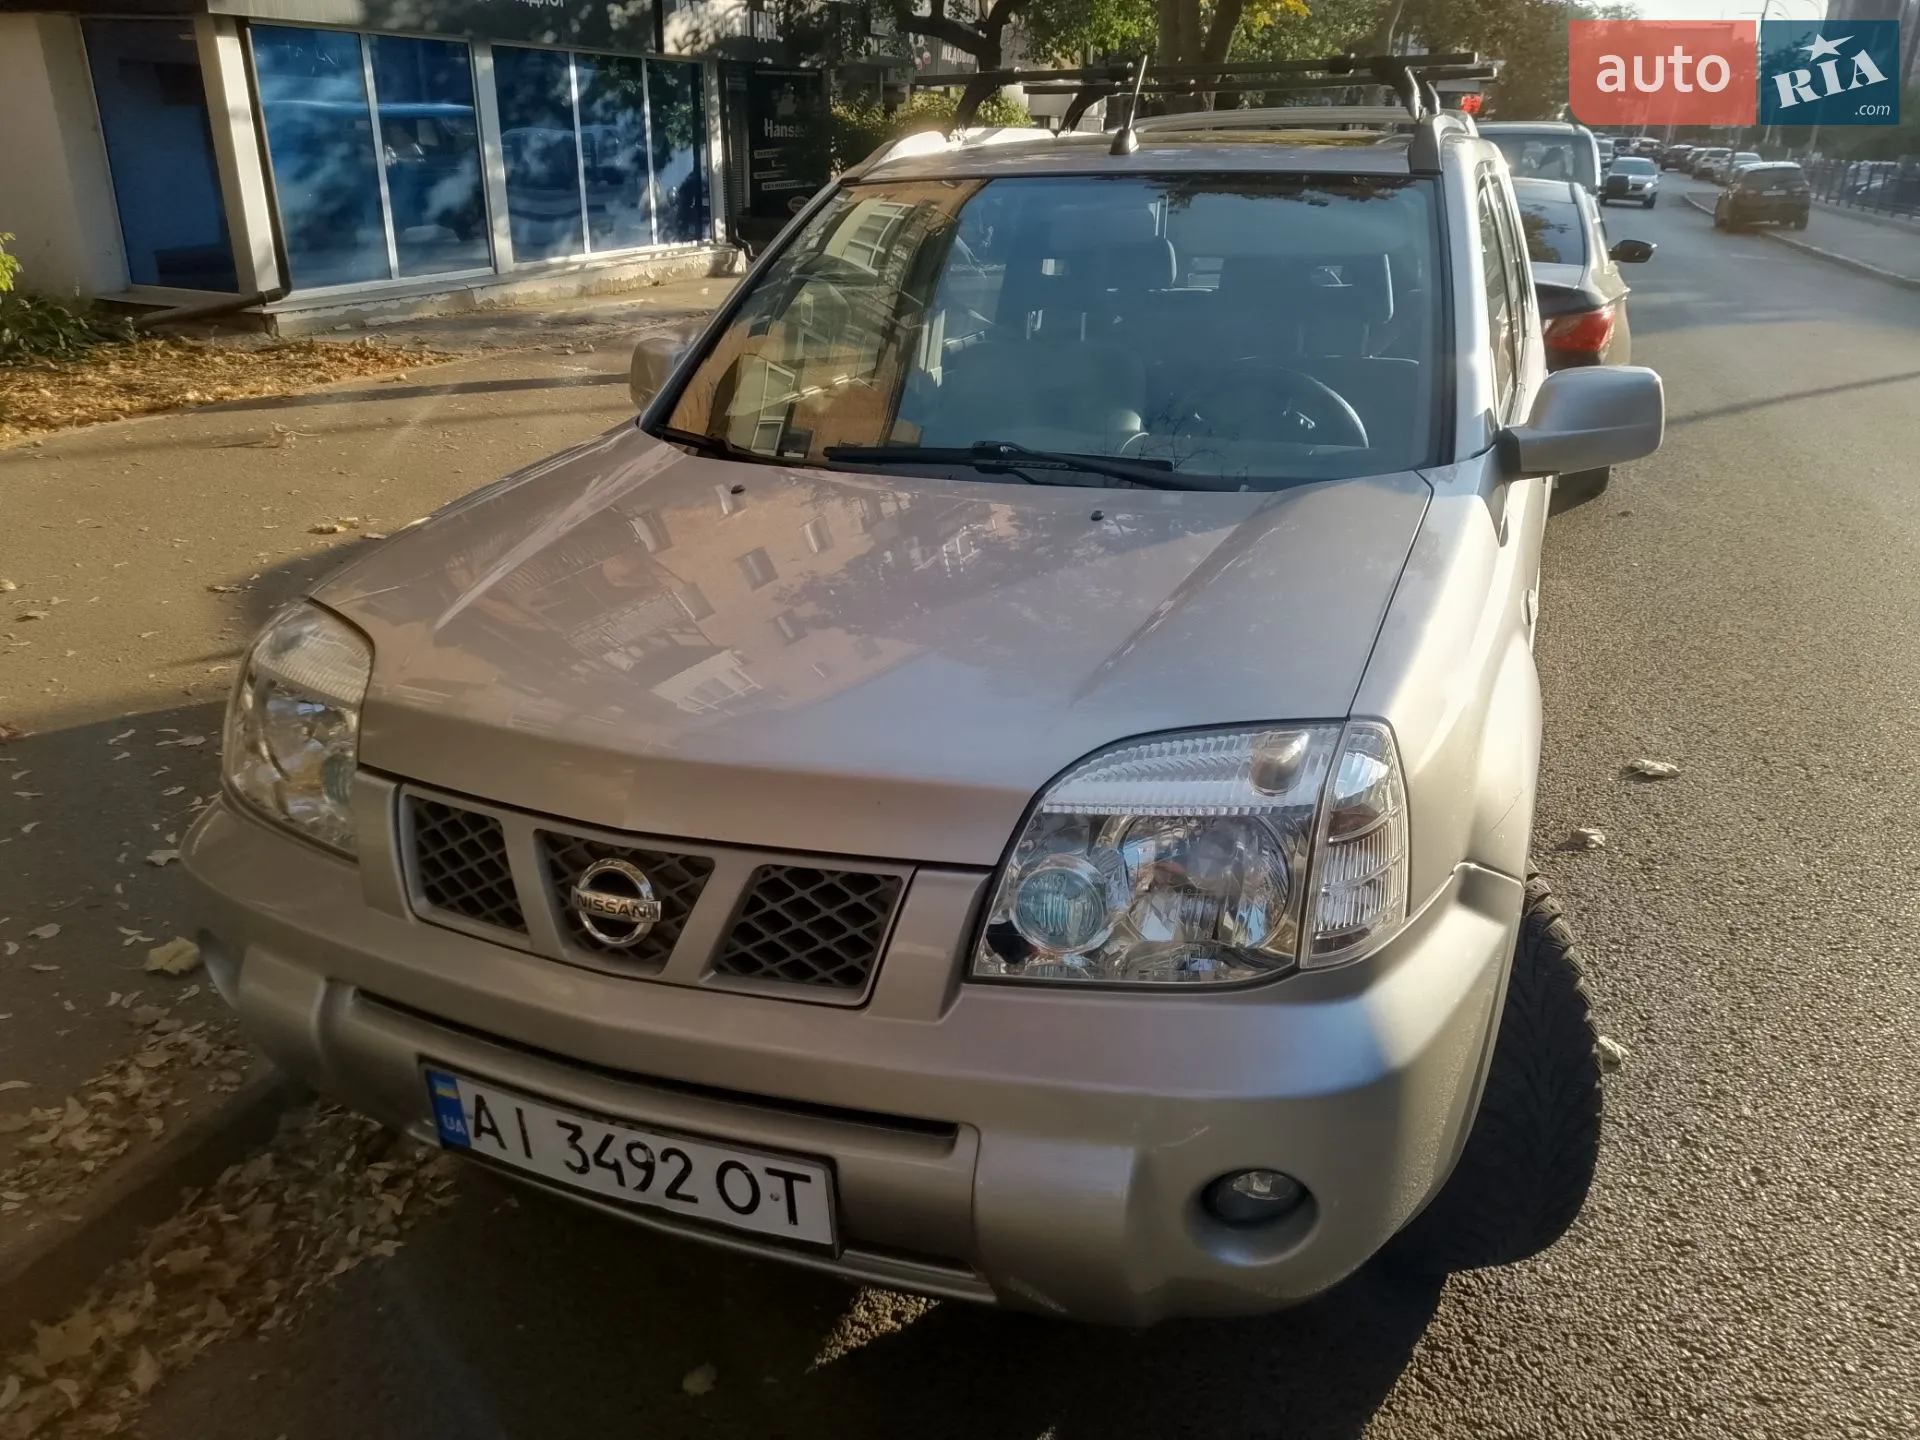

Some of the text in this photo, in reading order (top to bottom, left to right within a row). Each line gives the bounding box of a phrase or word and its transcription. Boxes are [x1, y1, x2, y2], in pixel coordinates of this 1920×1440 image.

[576, 894, 648, 918] NISSAN
[441, 1114, 467, 1137] UA
[474, 1094, 812, 1226] AI 3492 OT
